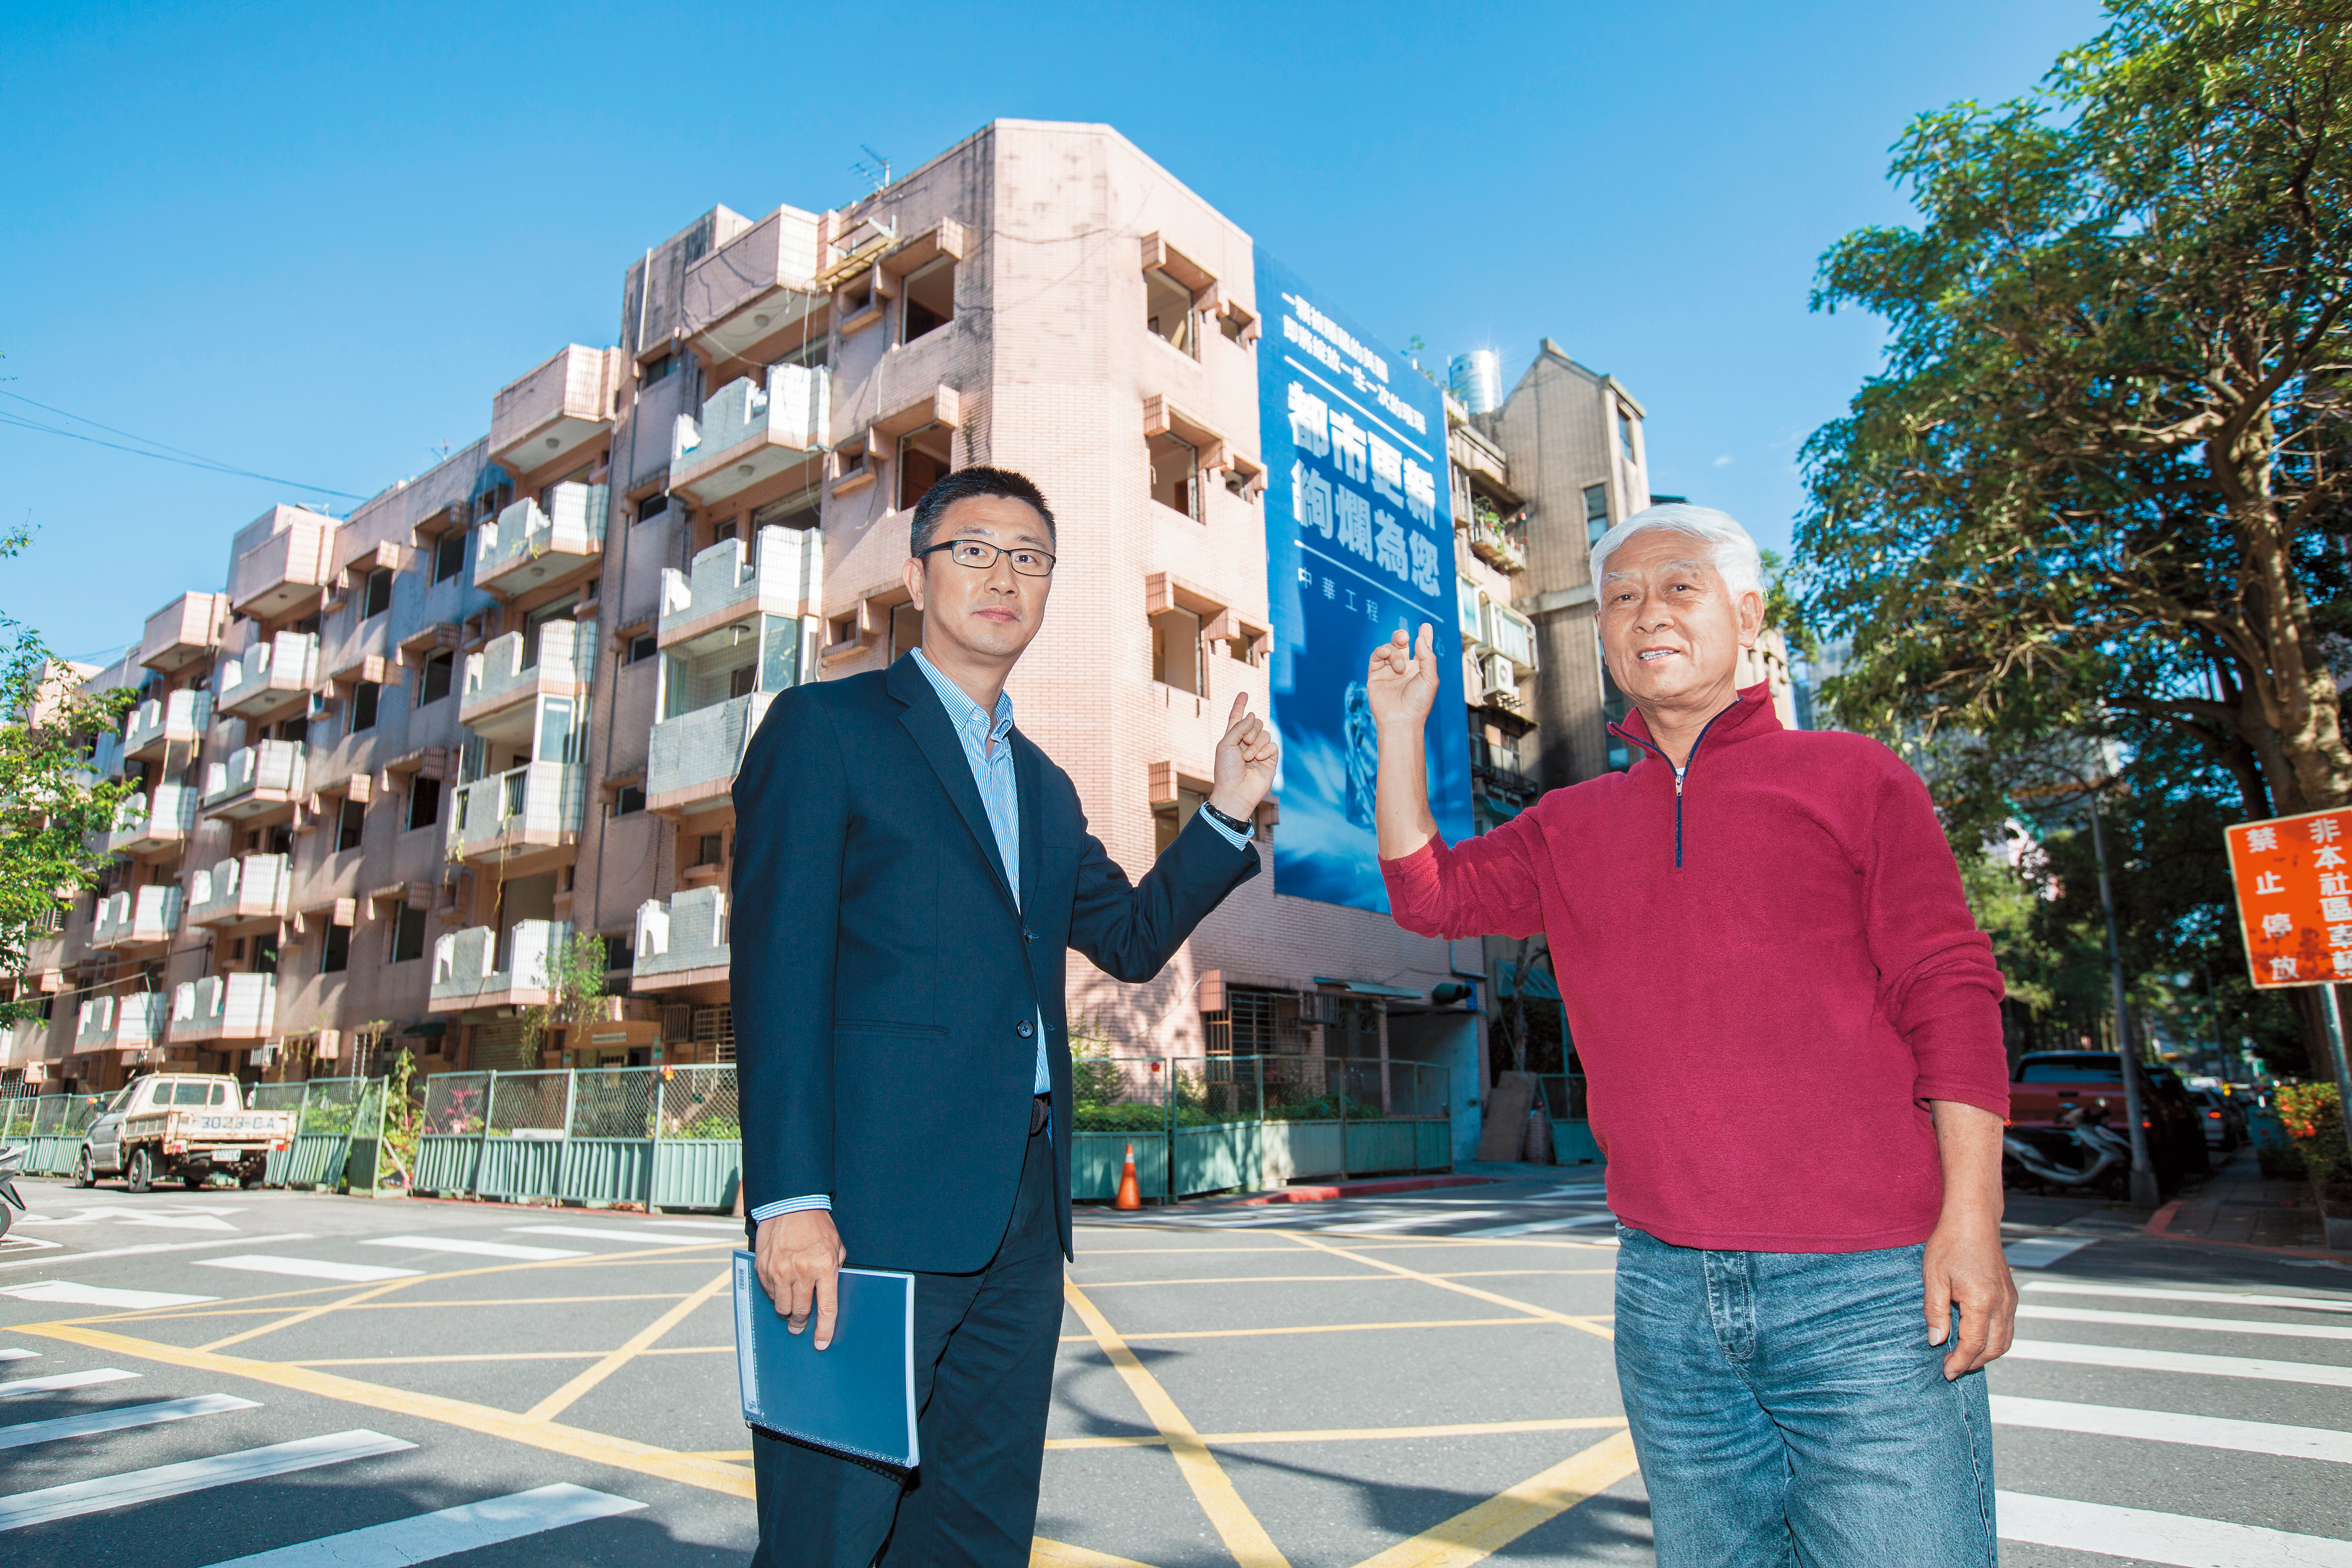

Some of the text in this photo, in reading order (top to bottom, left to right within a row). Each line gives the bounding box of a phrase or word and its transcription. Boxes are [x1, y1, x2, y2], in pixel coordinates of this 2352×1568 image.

[1287, 380, 1436, 531] 都市更新
[1291, 458, 1441, 597] 絢爛為您
[1298, 567, 1379, 623] 中華工程
[2245, 826, 2300, 981] 禁止停放
